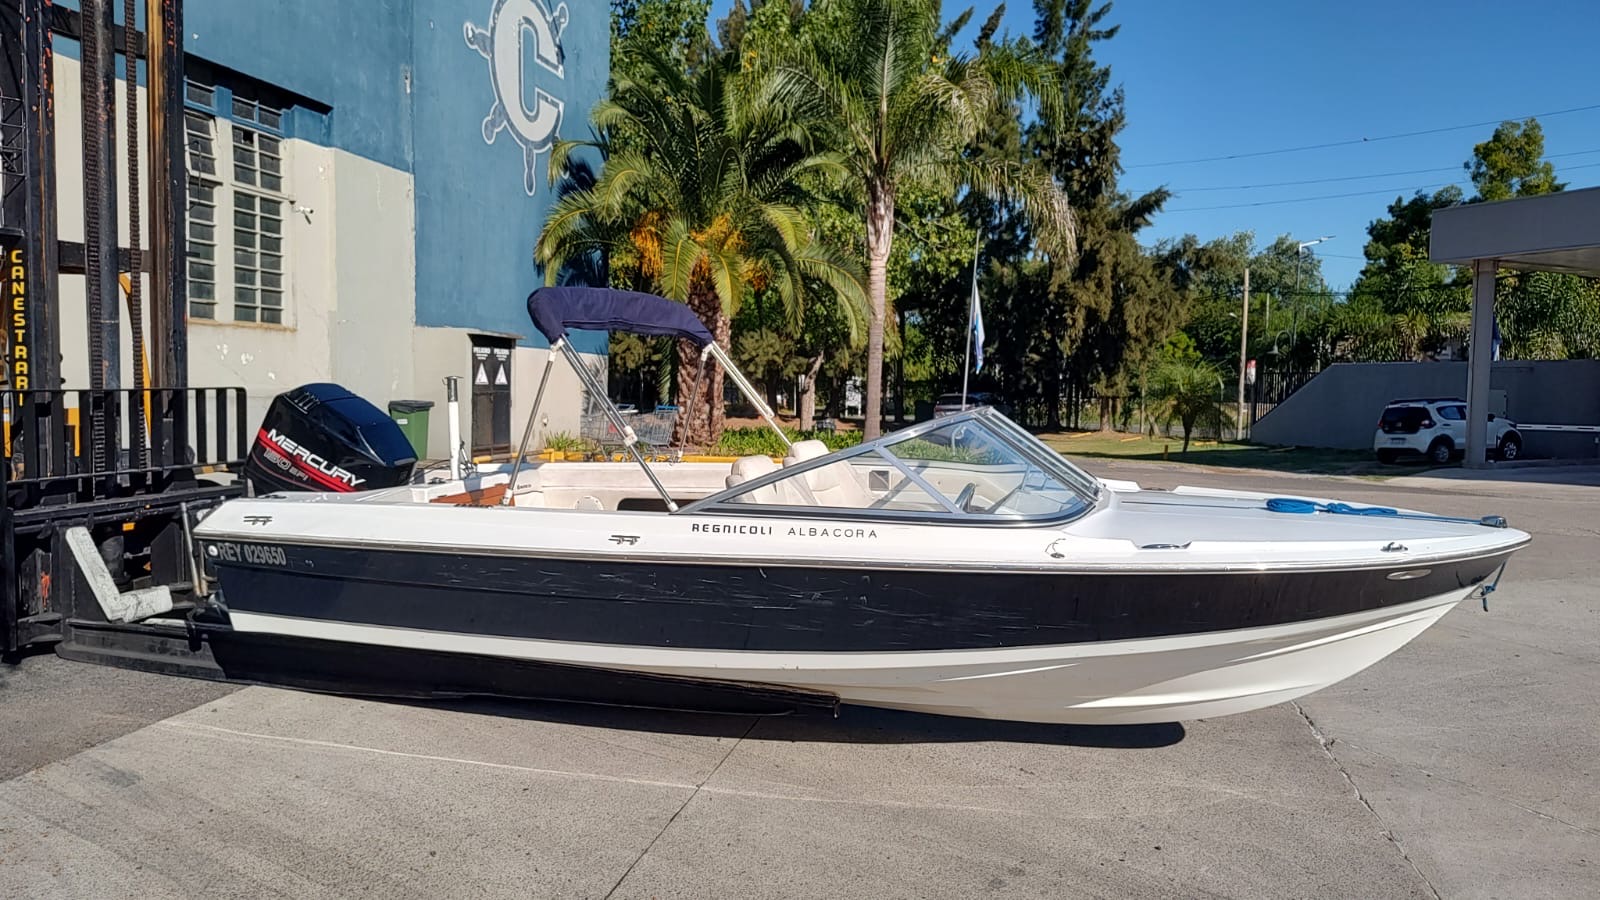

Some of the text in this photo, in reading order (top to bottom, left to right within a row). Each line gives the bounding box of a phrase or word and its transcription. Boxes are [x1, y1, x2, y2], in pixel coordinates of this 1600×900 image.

[11, 250, 28, 406] CANESTRARI
[267, 428, 366, 486] MERCURY
[691, 523, 878, 538] REGNICOLI ALBACORA
[217, 542, 287, 566] REY 029650
